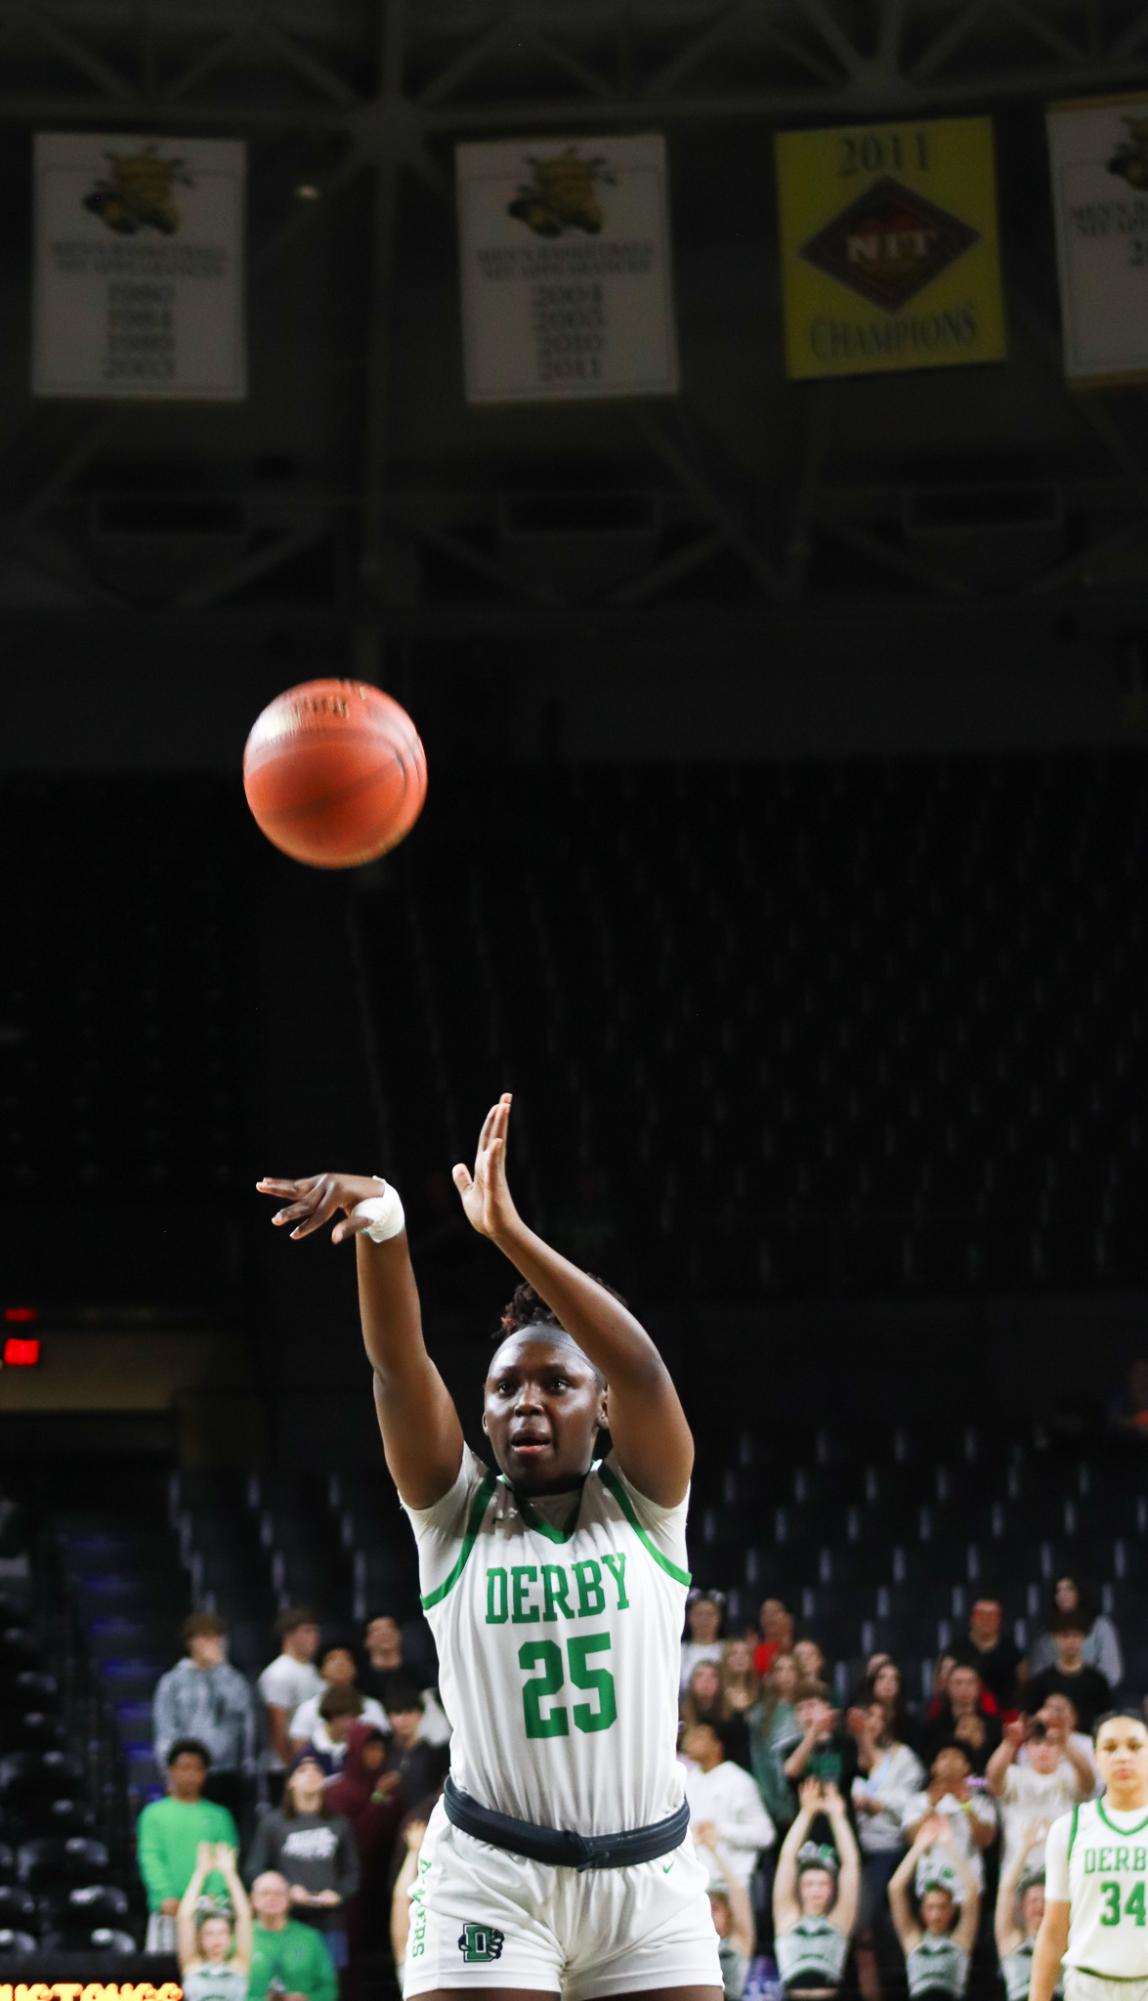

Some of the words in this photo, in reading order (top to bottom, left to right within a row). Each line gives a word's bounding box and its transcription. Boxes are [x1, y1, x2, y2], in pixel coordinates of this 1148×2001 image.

[838, 132, 932, 179] 2011
[846, 229, 940, 264] NIT
[810, 304, 980, 363] CHAMPIONS
[486, 1553, 630, 1624] DERBY
[519, 1632, 618, 1739] 25
[1100, 1880, 1148, 1928] 34
